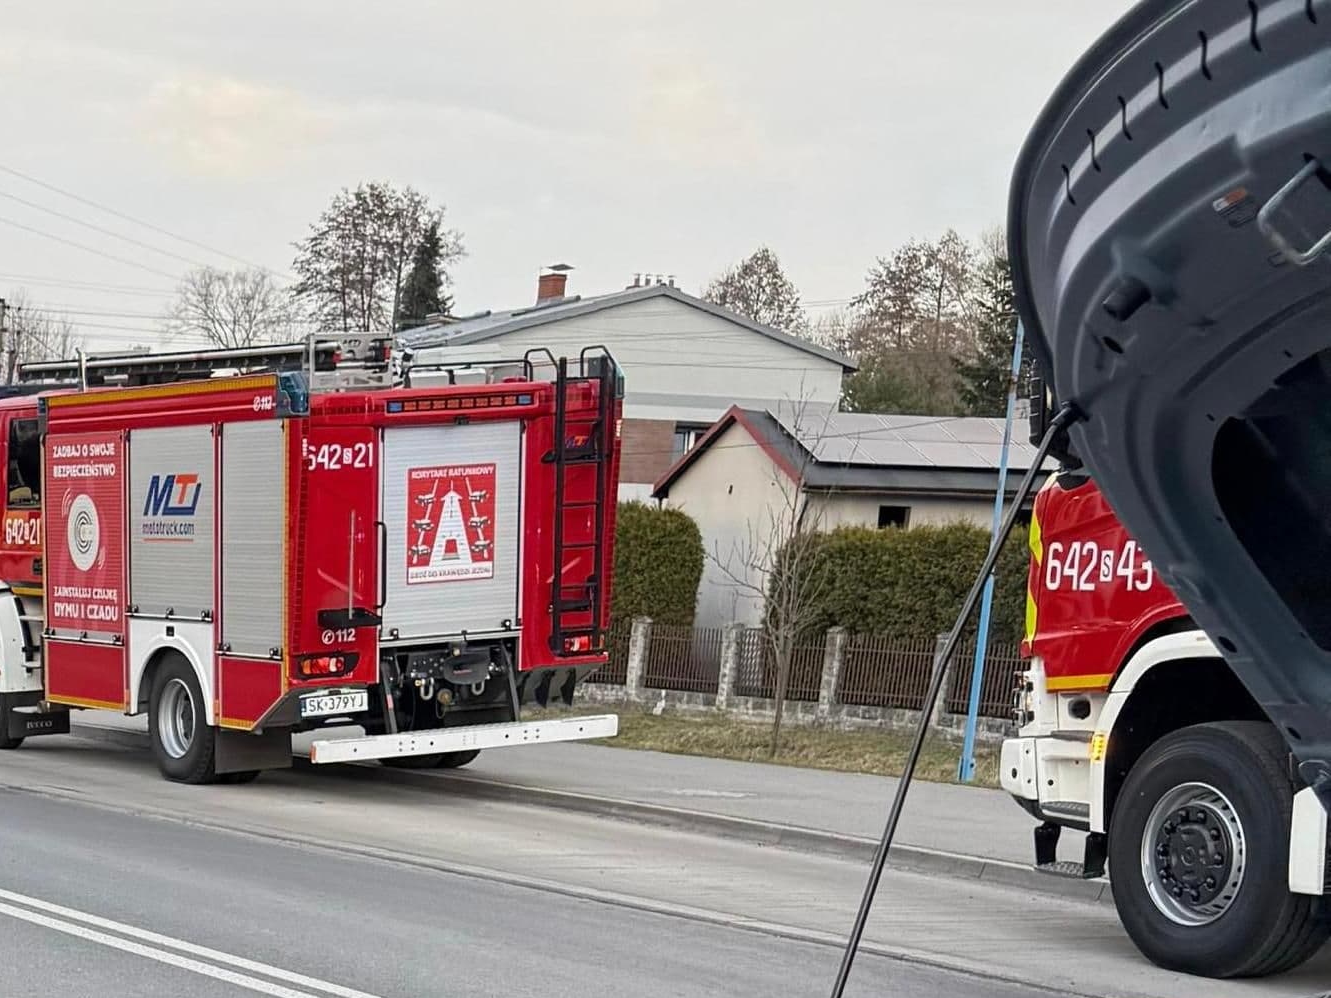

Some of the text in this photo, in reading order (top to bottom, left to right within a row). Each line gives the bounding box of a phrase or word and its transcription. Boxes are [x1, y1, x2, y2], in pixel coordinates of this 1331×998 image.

[53, 443, 115, 458] ZADBAJ O SWOJE
[53, 460, 116, 478] BEZPIECZEŃSTWO
[54, 602, 118, 621] DYMU I CZADU
[335, 628, 356, 643] 112
[309, 694, 364, 712] SK 379YJ
